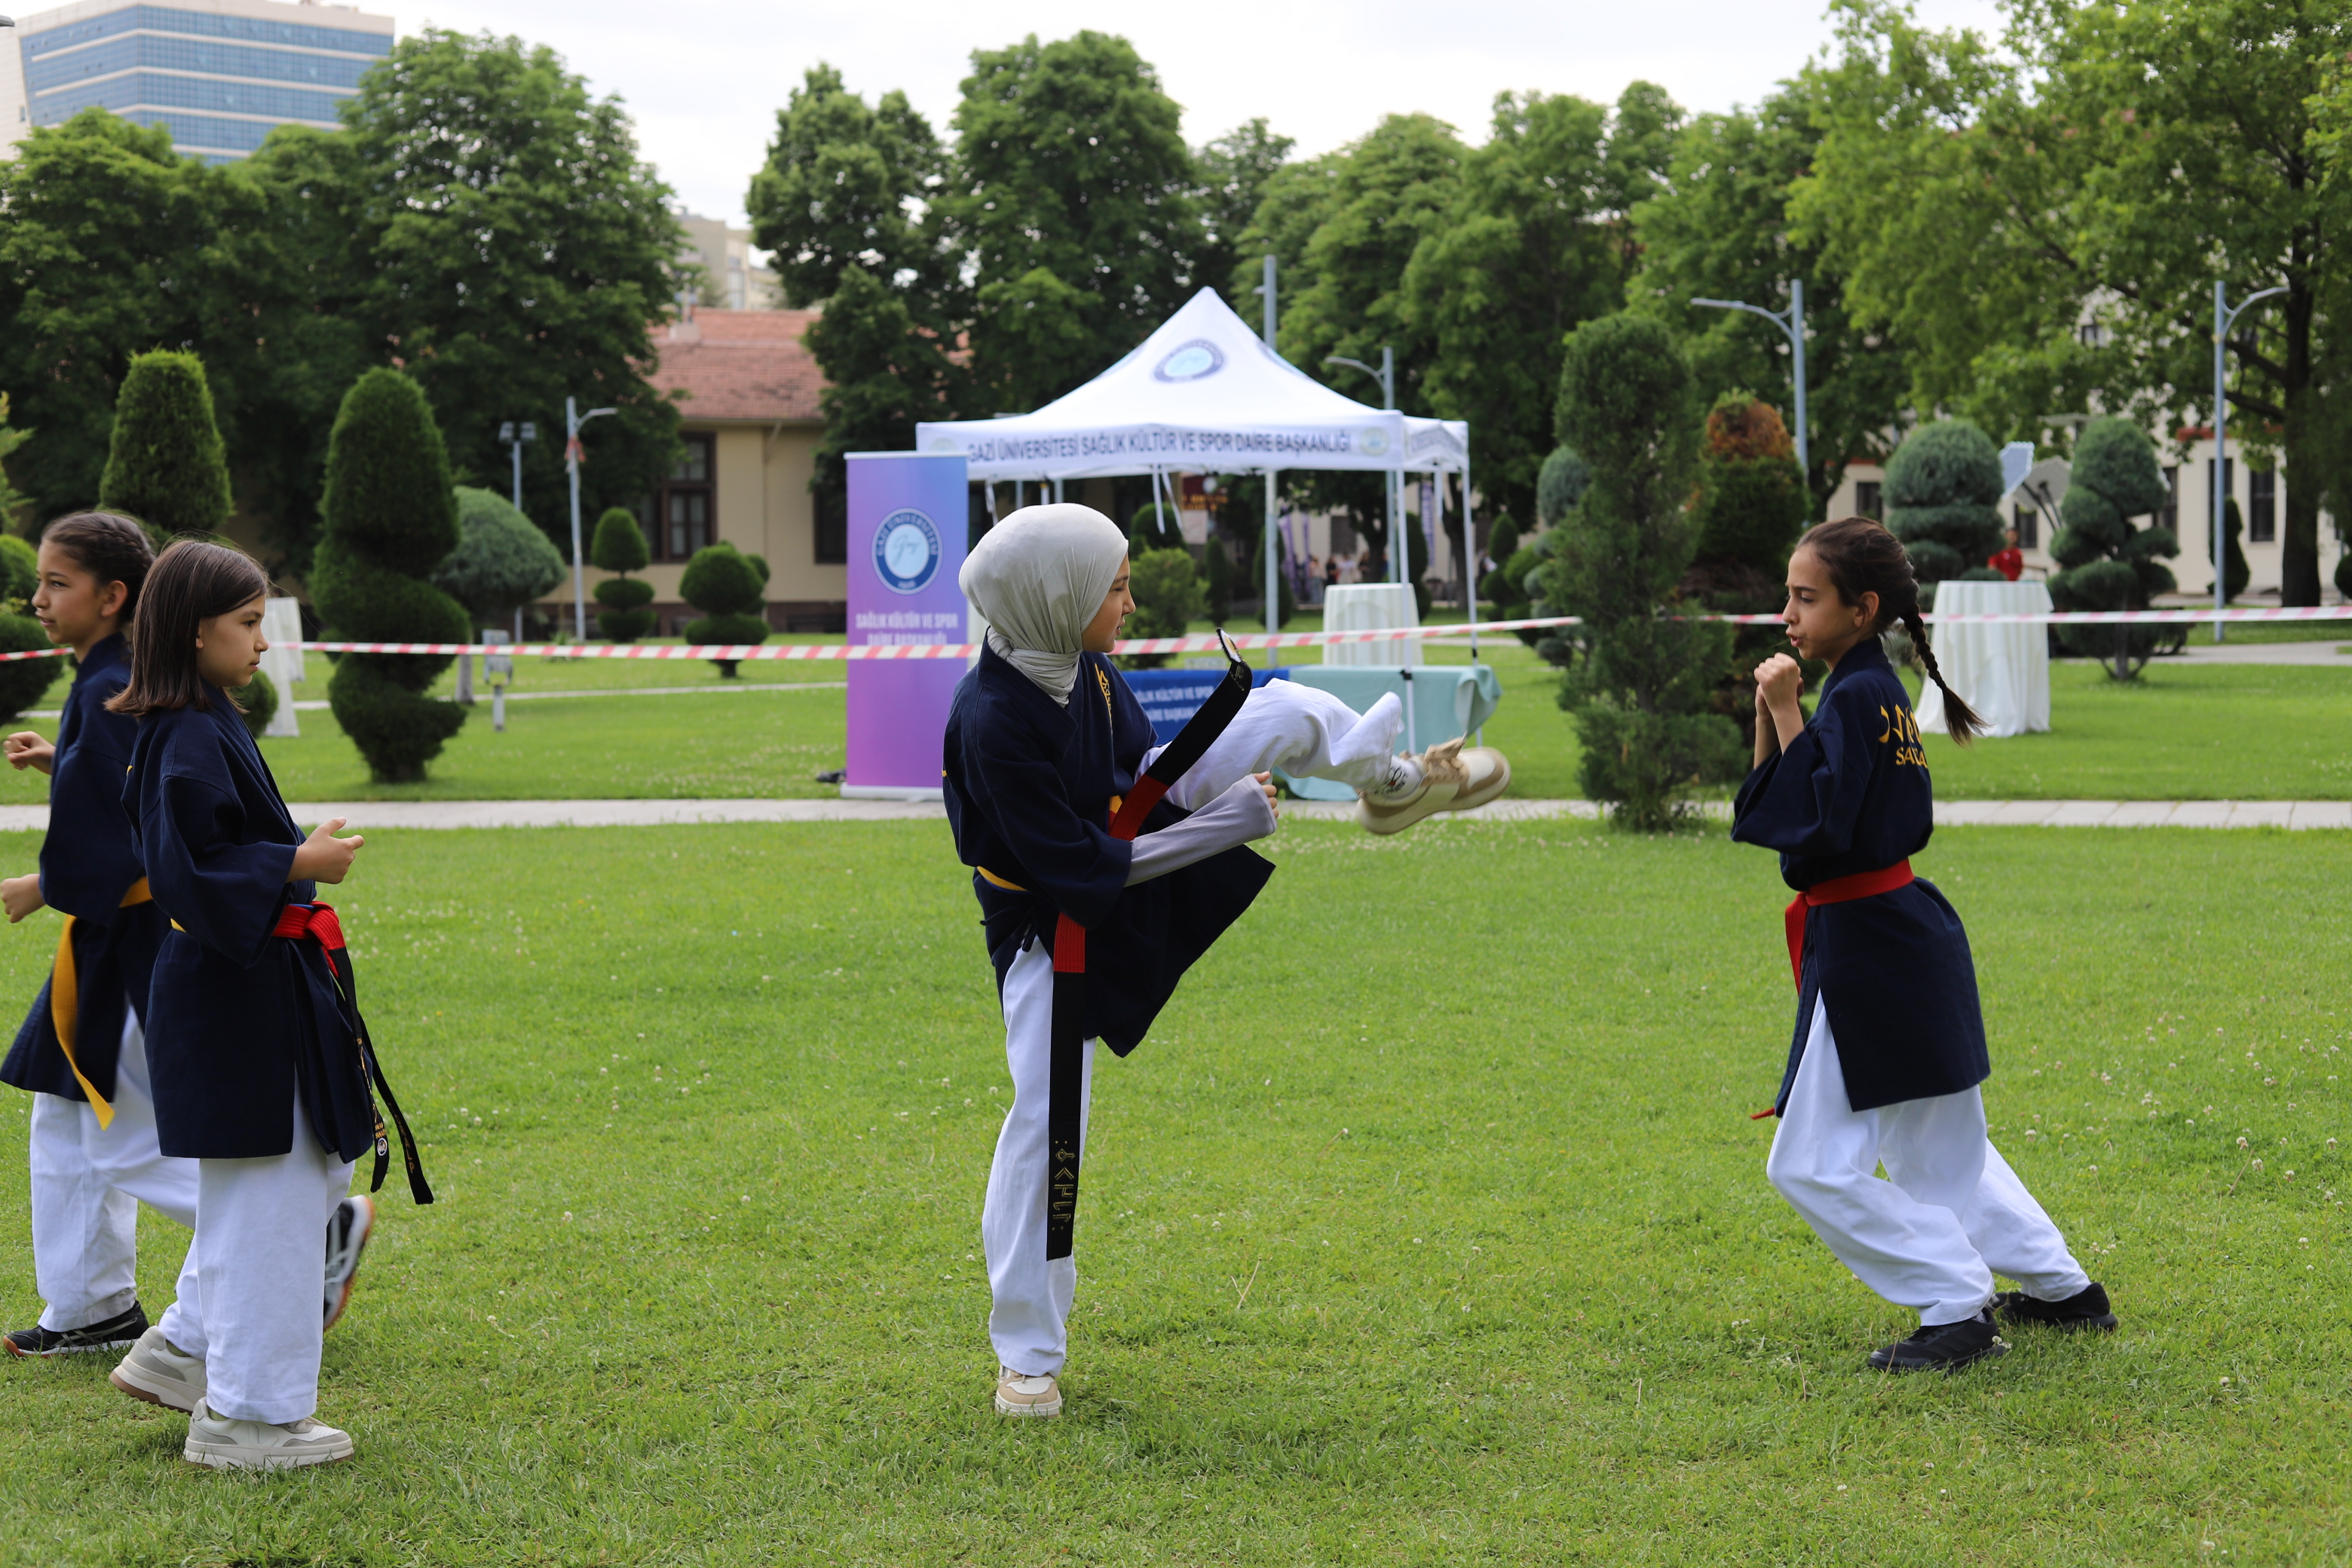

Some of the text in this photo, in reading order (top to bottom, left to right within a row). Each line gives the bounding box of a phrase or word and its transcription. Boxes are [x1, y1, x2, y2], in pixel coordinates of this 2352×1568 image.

[1080, 431, 1127, 455] SAĞLIK
[1128, 428, 1178, 452] KÜLTÜR
[1180, 432, 1196, 452] VE
[1199, 432, 1233, 452] SPOR
[1236, 430, 1272, 452] DAİRE
[1275, 429, 1352, 457] BAŞKANLIĞI
[921, 612, 933, 629] VE
[934, 612, 959, 629] SPOR
